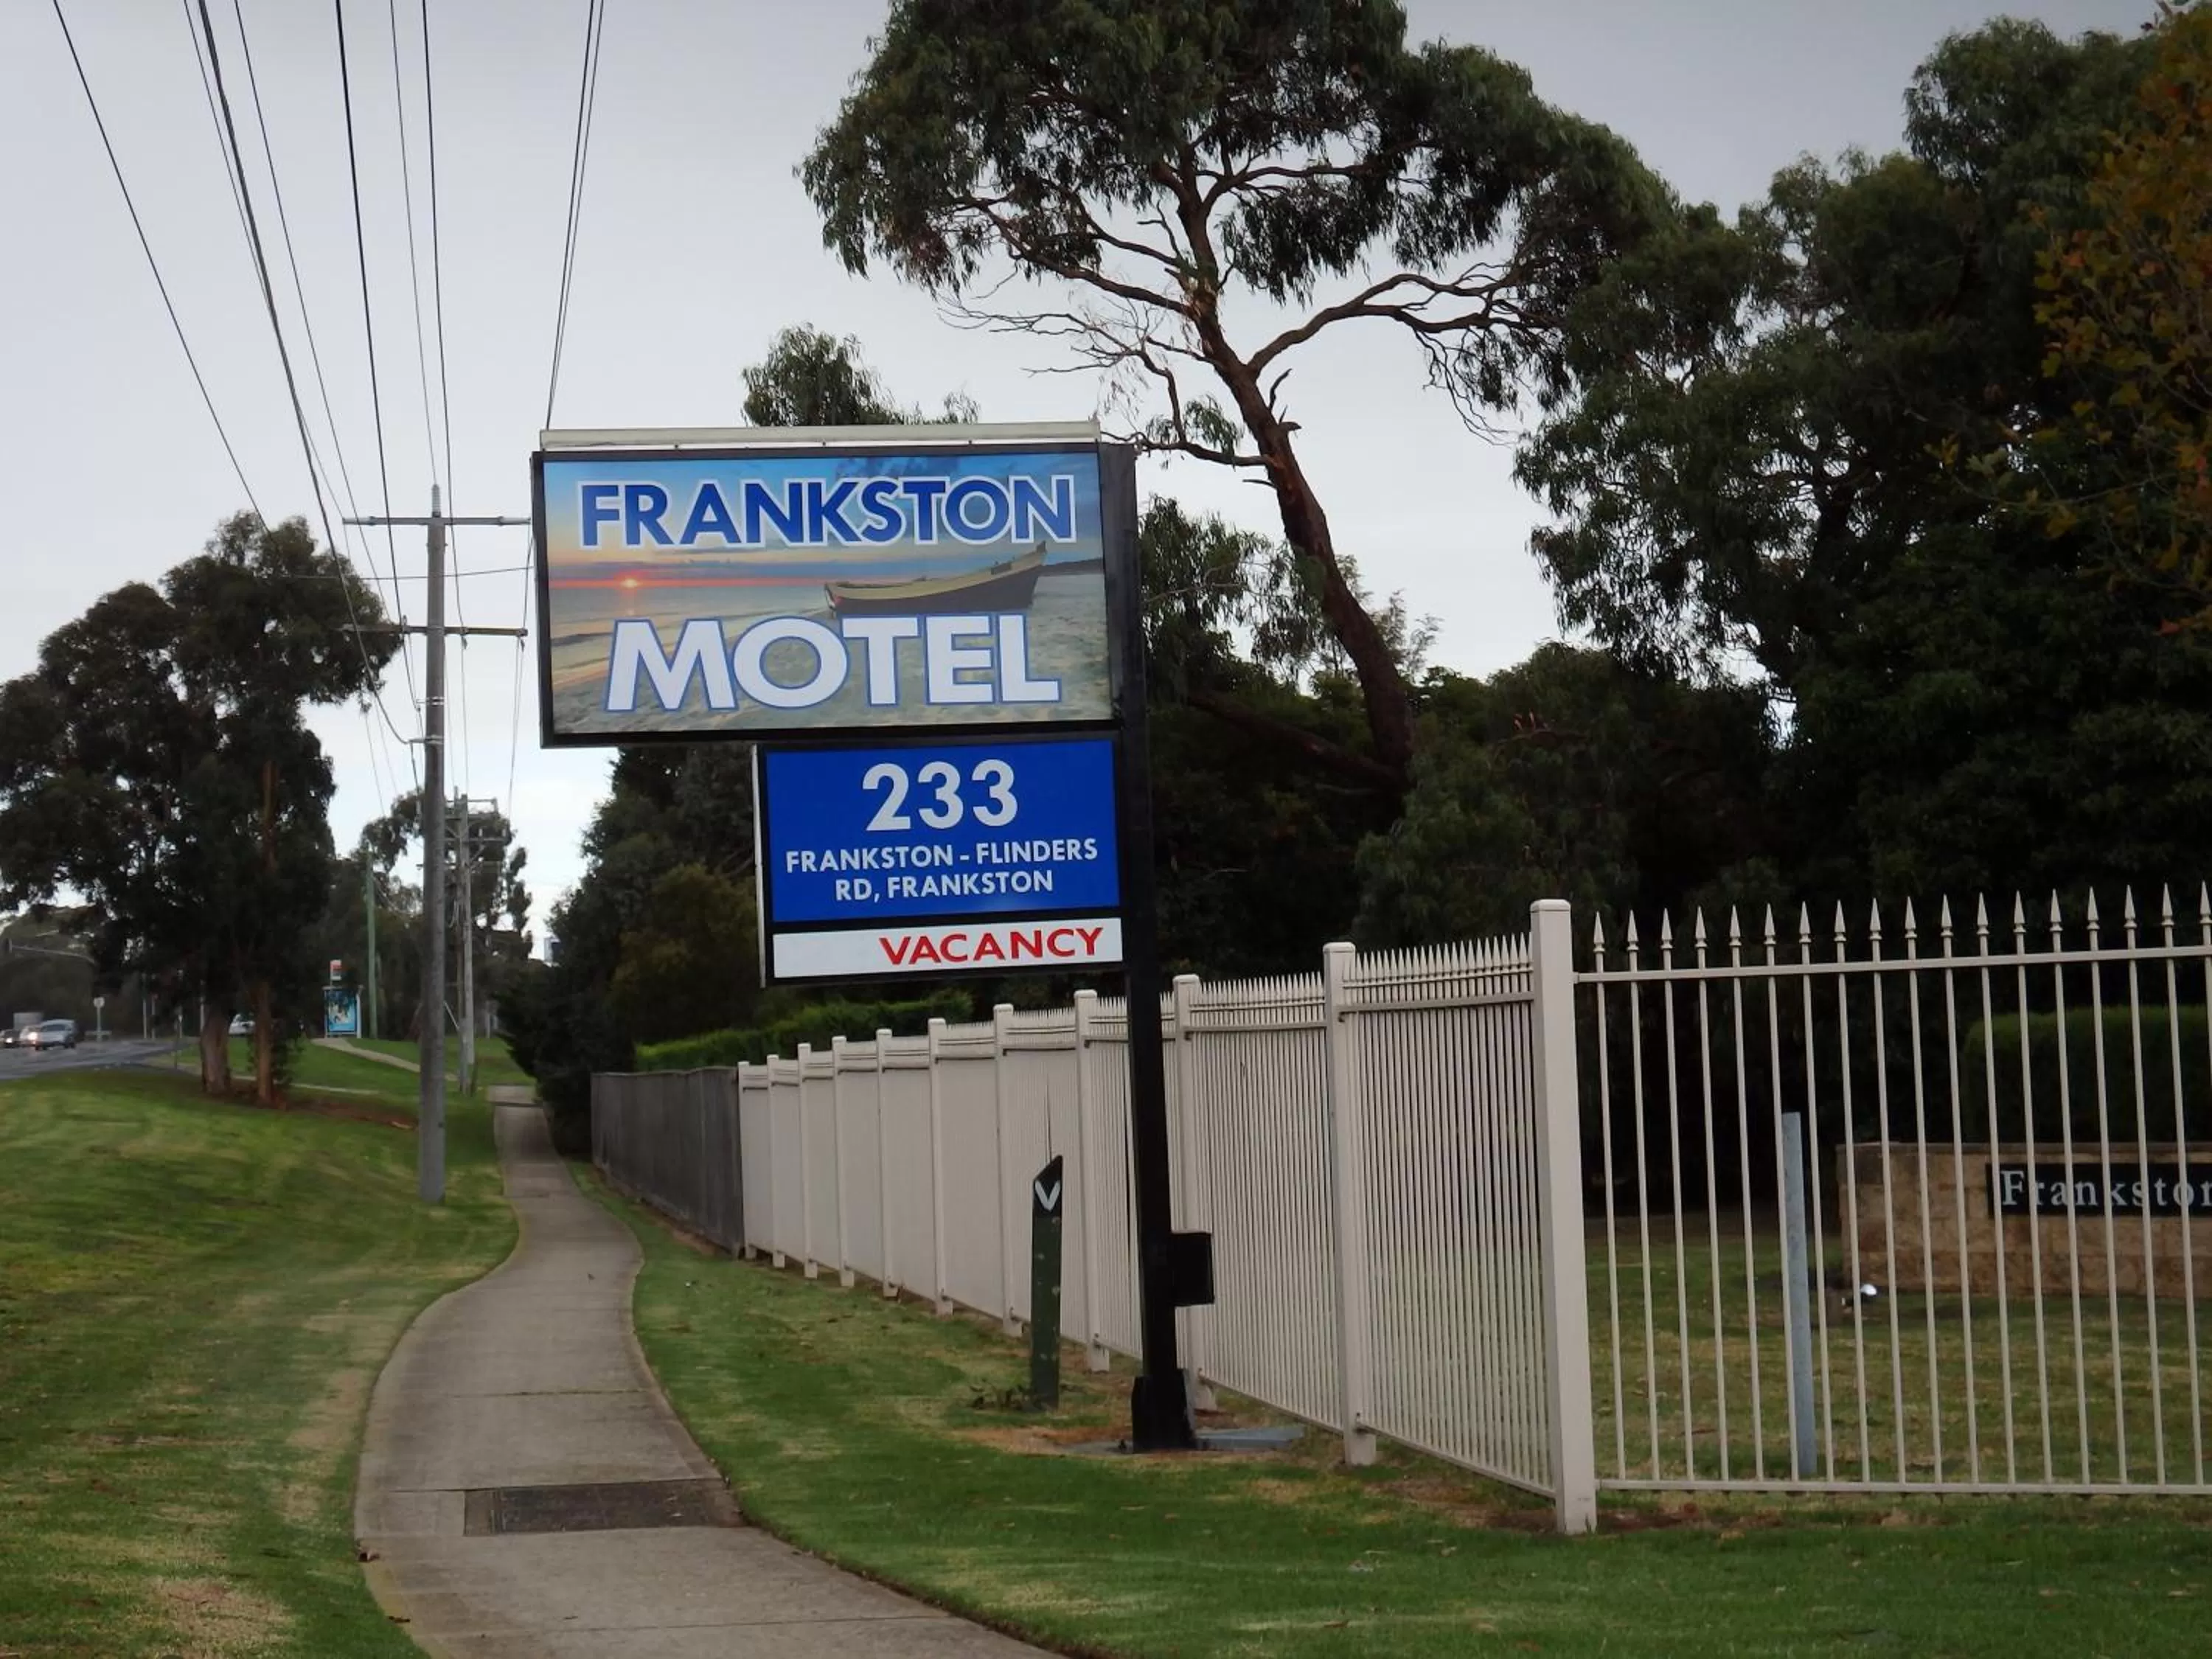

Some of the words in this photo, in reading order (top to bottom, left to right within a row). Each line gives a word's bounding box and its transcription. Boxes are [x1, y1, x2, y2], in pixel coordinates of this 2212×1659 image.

[577, 475, 1076, 548] FRANKSTON
[606, 614, 1062, 712] MOTEL
[862, 759, 1018, 831] 233
[786, 844, 953, 873] FRANKSTON
[976, 838, 1099, 865] FLINDERS
[835, 878, 880, 903] RD,
[887, 869, 1054, 899] FRANKSTON
[880, 927, 1103, 965] VACANCY
